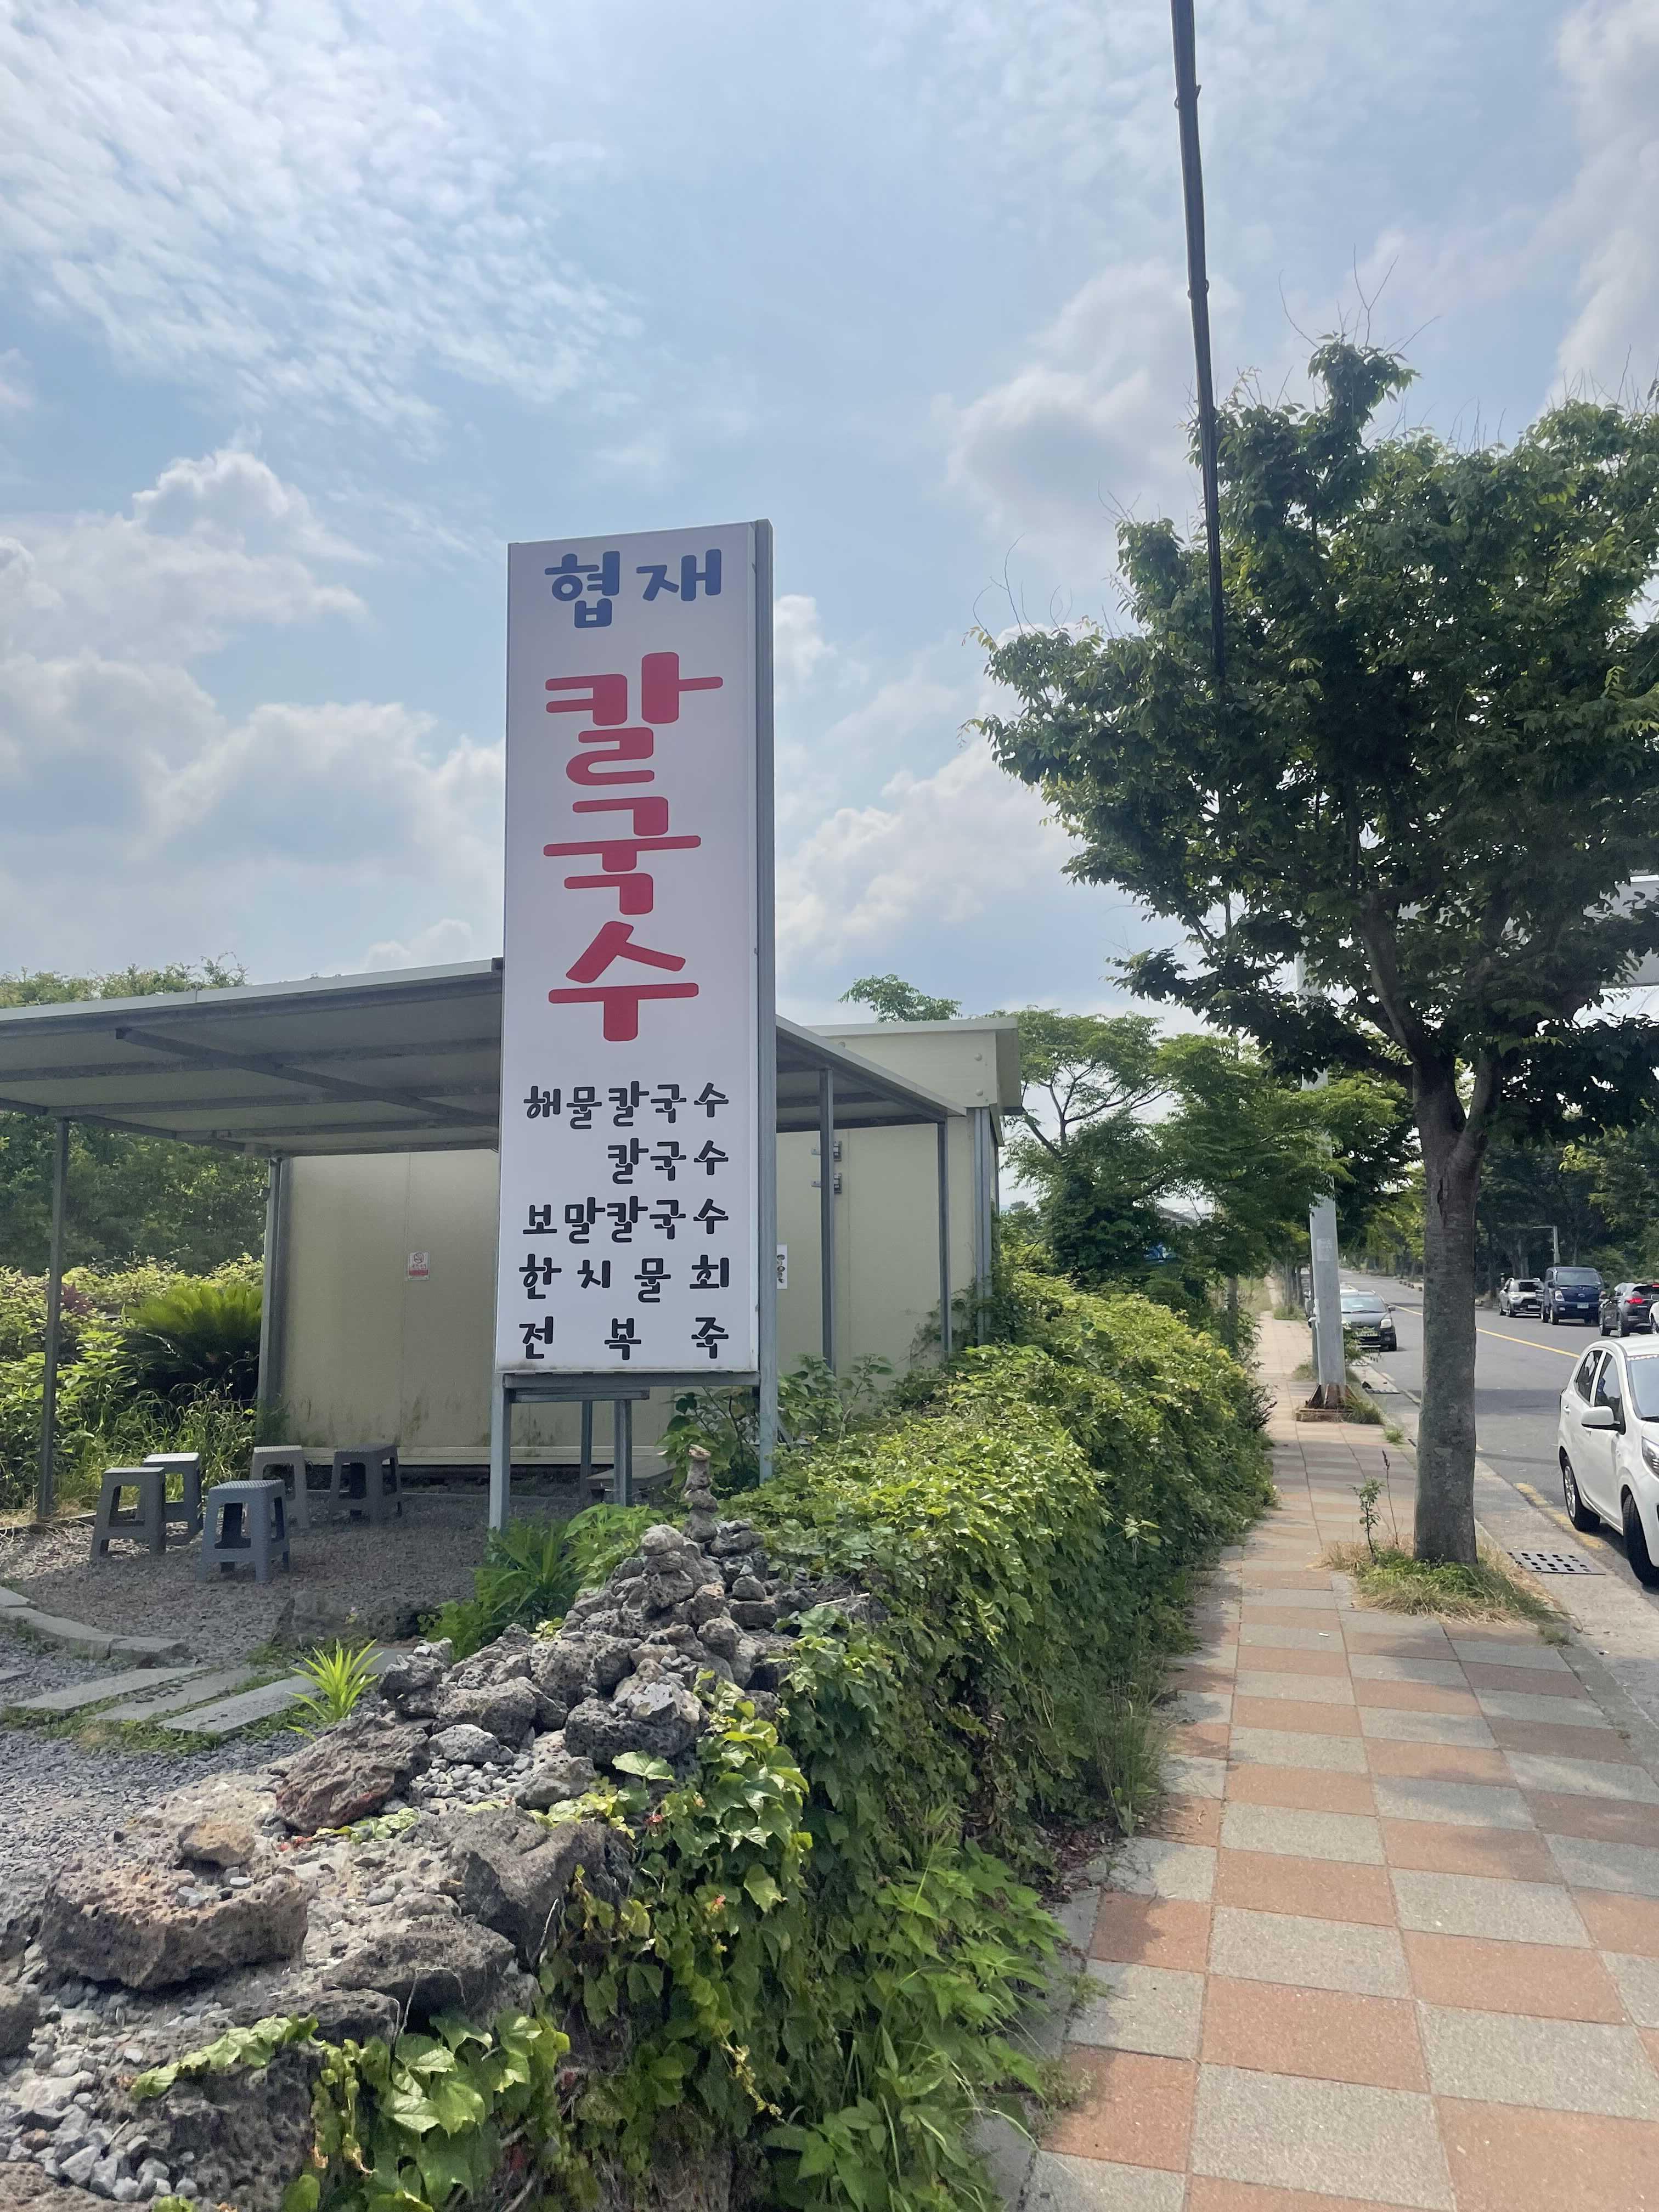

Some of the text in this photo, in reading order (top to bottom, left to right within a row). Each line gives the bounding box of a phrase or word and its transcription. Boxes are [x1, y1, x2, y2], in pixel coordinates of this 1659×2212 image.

[544, 549, 723, 629] 협재
[543, 652, 724, 1042] 칼국수
[523, 1080, 729, 1130] 해물칼국수
[607, 1137, 729, 1184] 칼국수
[522, 1195, 729, 1244] 보말칼국수
[518, 1253, 730, 1303] 한치물회
